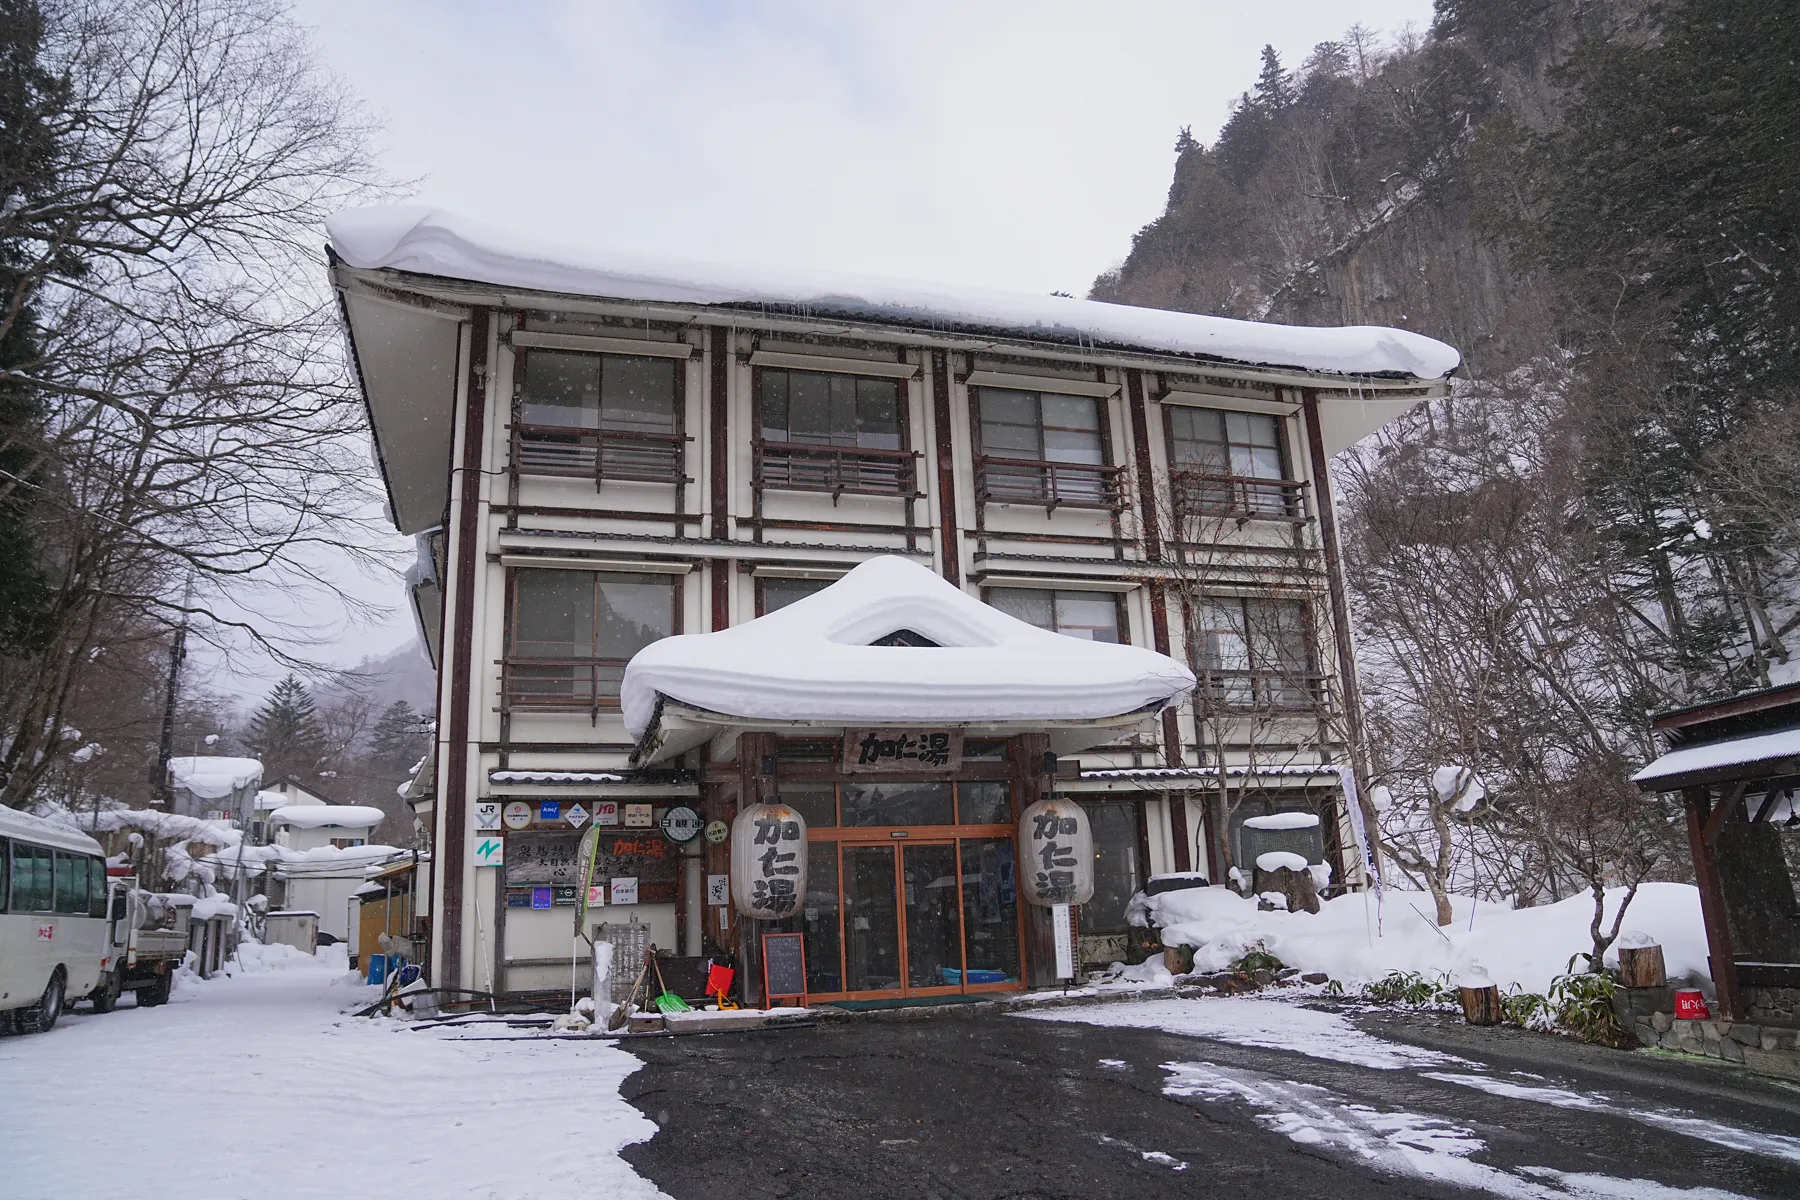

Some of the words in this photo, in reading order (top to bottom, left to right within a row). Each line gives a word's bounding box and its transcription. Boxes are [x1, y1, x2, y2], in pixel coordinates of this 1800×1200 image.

[859, 732, 950, 767] 加仁湯
[480, 805, 494, 813] JR
[595, 803, 616, 816] JTB
[612, 839, 664, 858] 加仁湯
[1033, 809, 1078, 900] 加仁湯
[752, 814, 800, 914] 加仁湯
